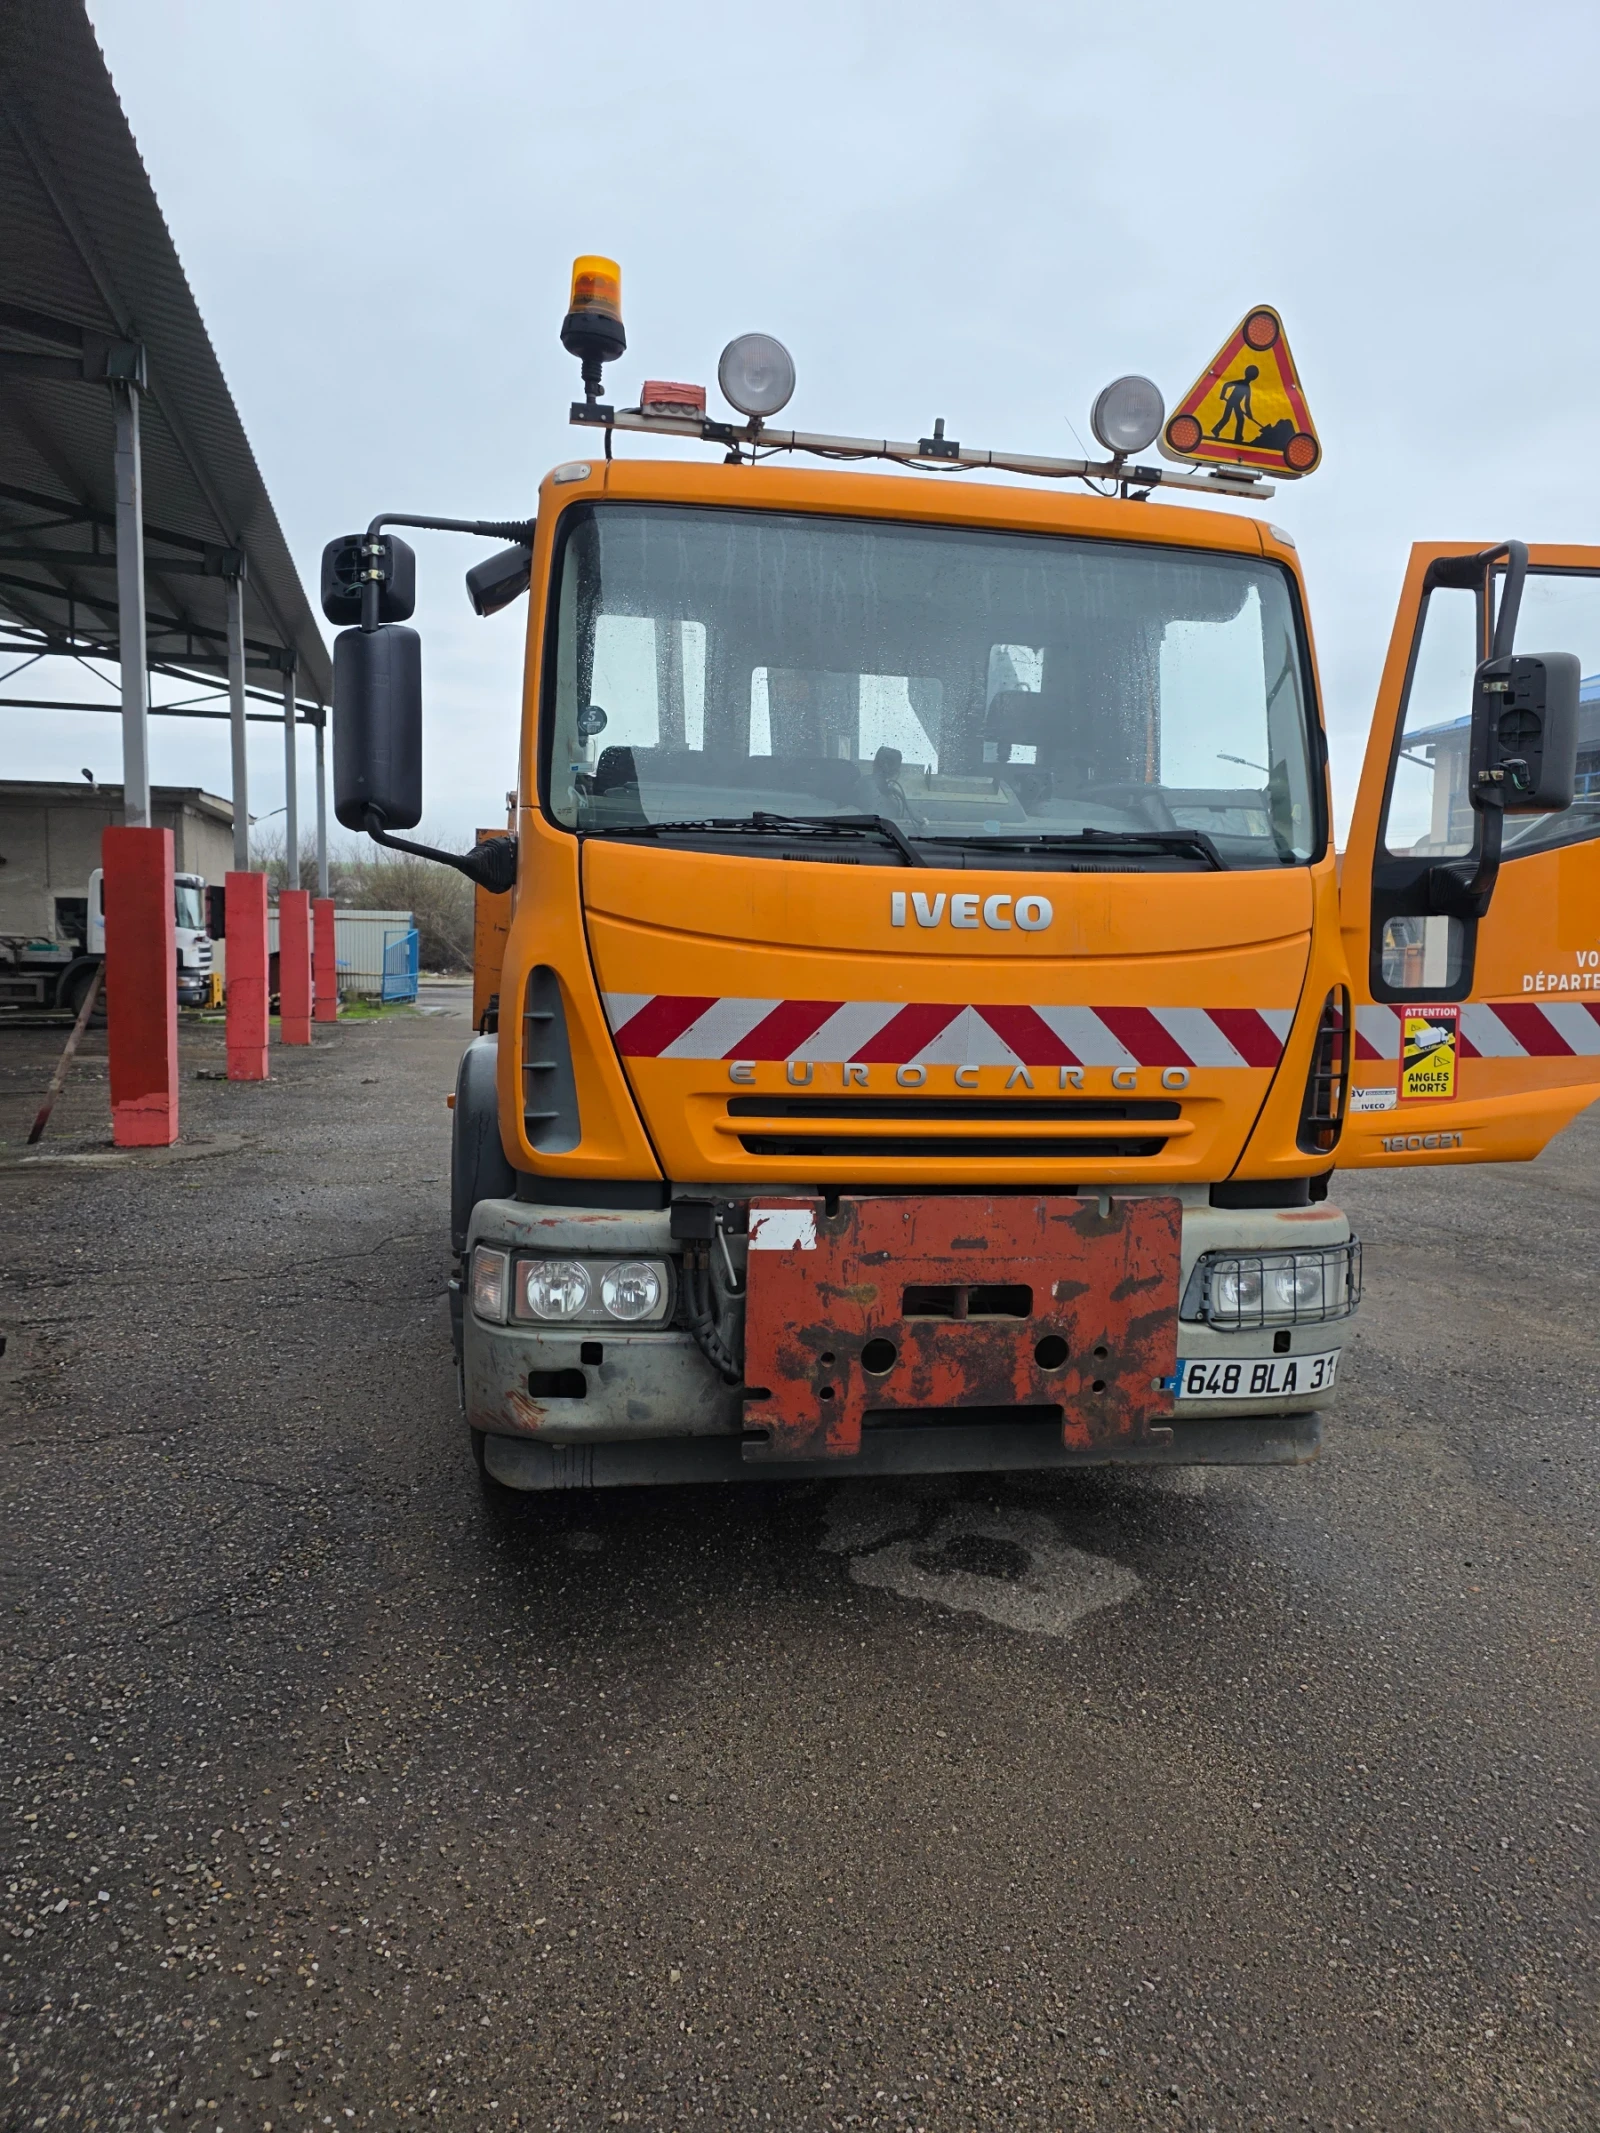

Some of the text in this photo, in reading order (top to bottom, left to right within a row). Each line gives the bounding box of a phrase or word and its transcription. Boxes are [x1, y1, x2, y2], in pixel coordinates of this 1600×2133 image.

[891, 891, 1054, 931] IVECO
[1576, 950, 1599, 968] VO
[1523, 971, 1600, 992] DÉPARTE
[1405, 1007, 1457, 1017] ATTENTION
[728, 1060, 1191, 1090] EUROCARGO
[1407, 1072, 1450, 1082] ANGLES
[1409, 1083, 1447, 1093] MORTS
[1381, 1132, 1463, 1153] 180E21
[1187, 1355, 1334, 1394] 648 BLA 31
